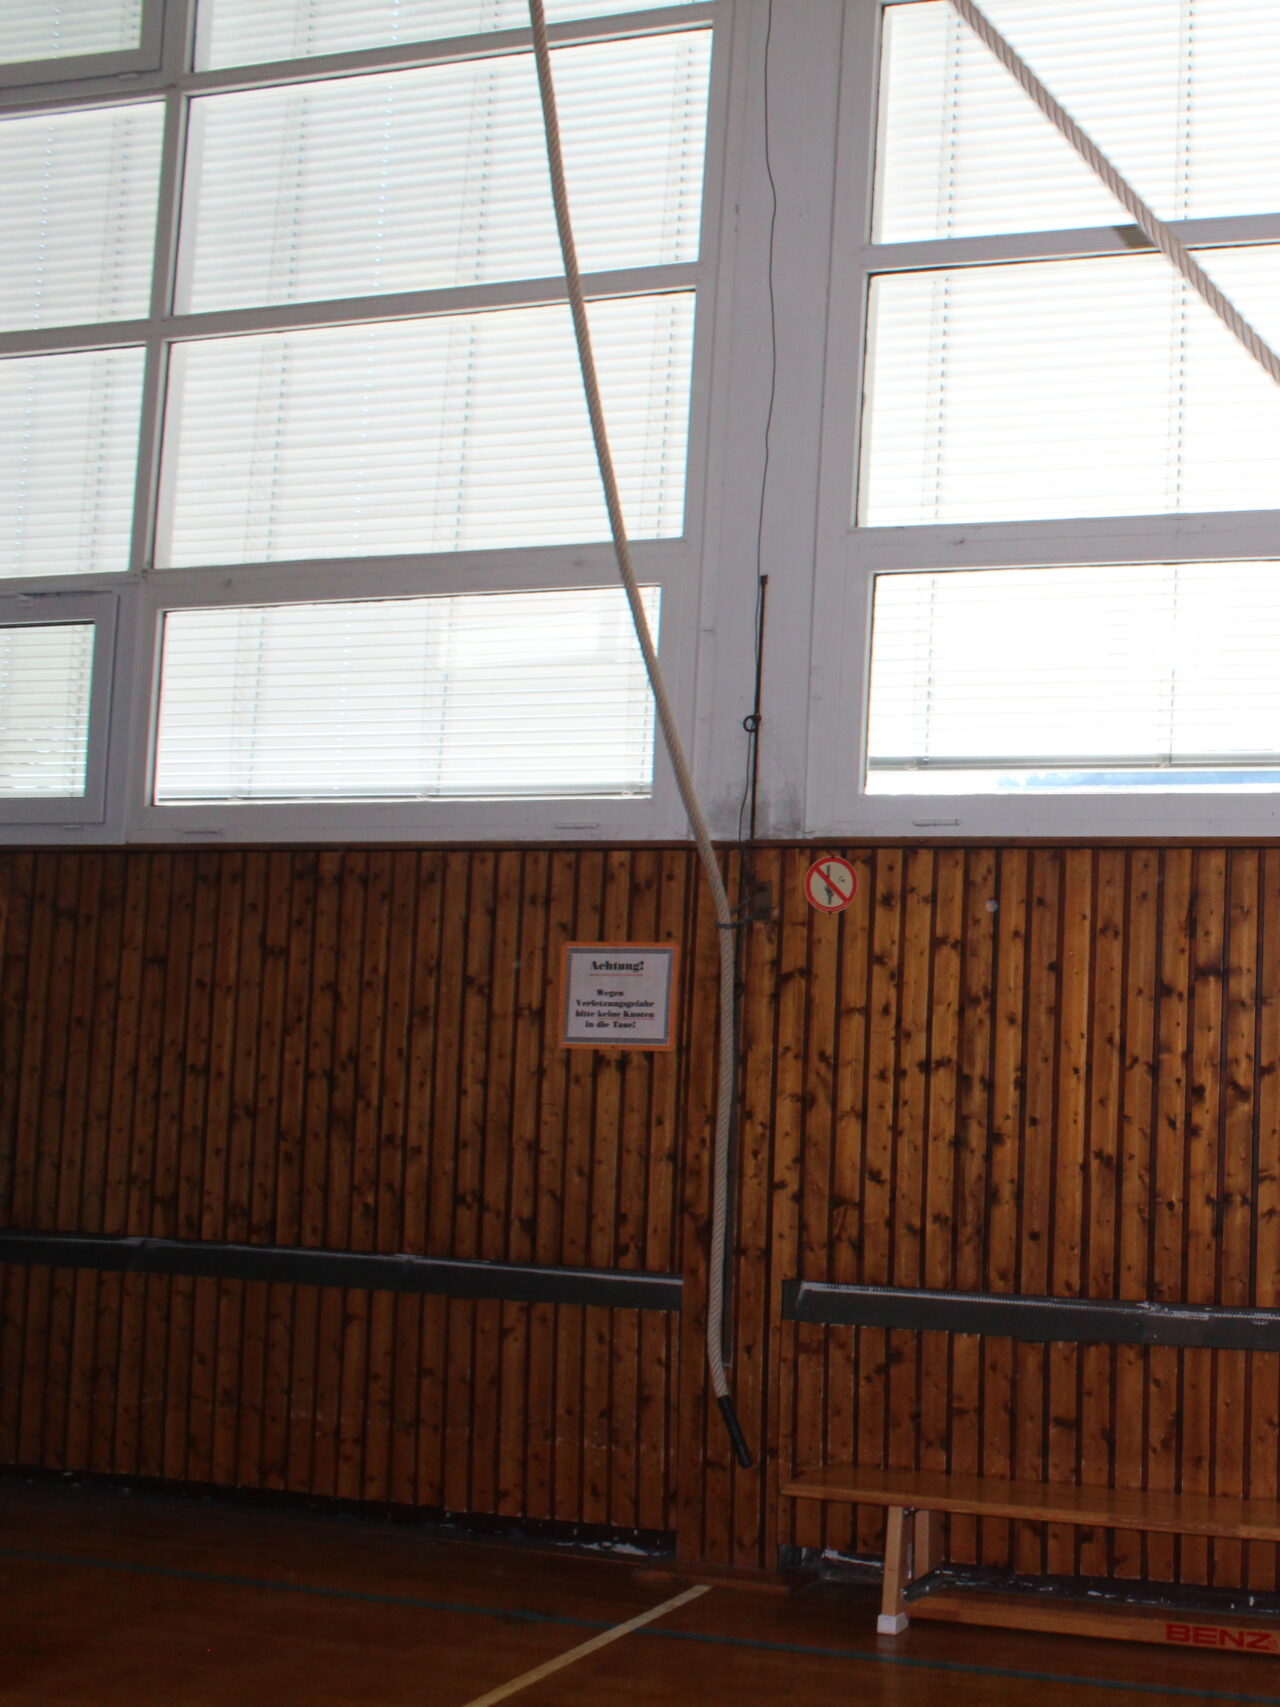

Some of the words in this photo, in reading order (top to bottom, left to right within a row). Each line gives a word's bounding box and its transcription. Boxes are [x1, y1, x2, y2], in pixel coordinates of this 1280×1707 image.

[592, 961, 644, 972] Achtung!
[596, 989, 624, 997] Wegen
[576, 999, 655, 1008] Verletzungsgefahr
[575, 1010, 595, 1018] bitte
[597, 1010, 622, 1018] keine
